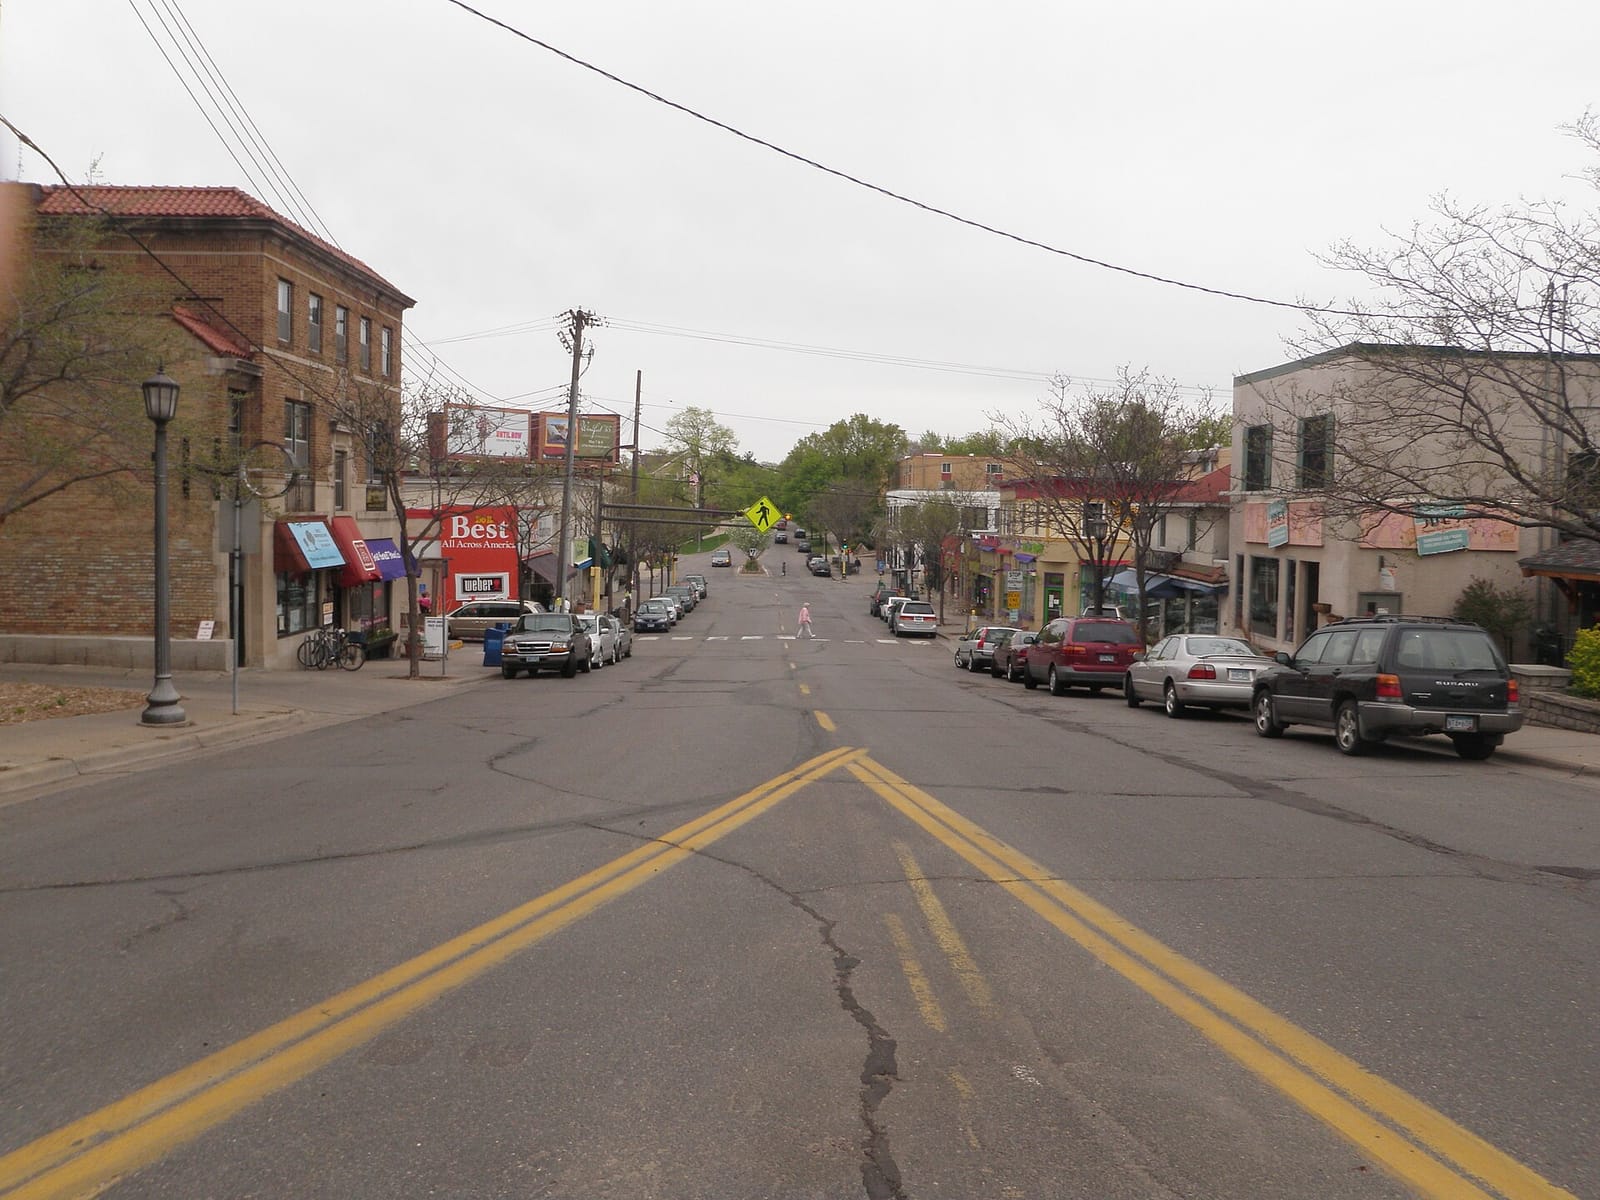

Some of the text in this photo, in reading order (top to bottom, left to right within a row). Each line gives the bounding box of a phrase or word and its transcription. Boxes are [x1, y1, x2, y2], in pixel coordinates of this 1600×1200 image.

[450, 515, 510, 539] Best
[441, 540, 516, 549] All Across America
[464, 577, 493, 592] weber
